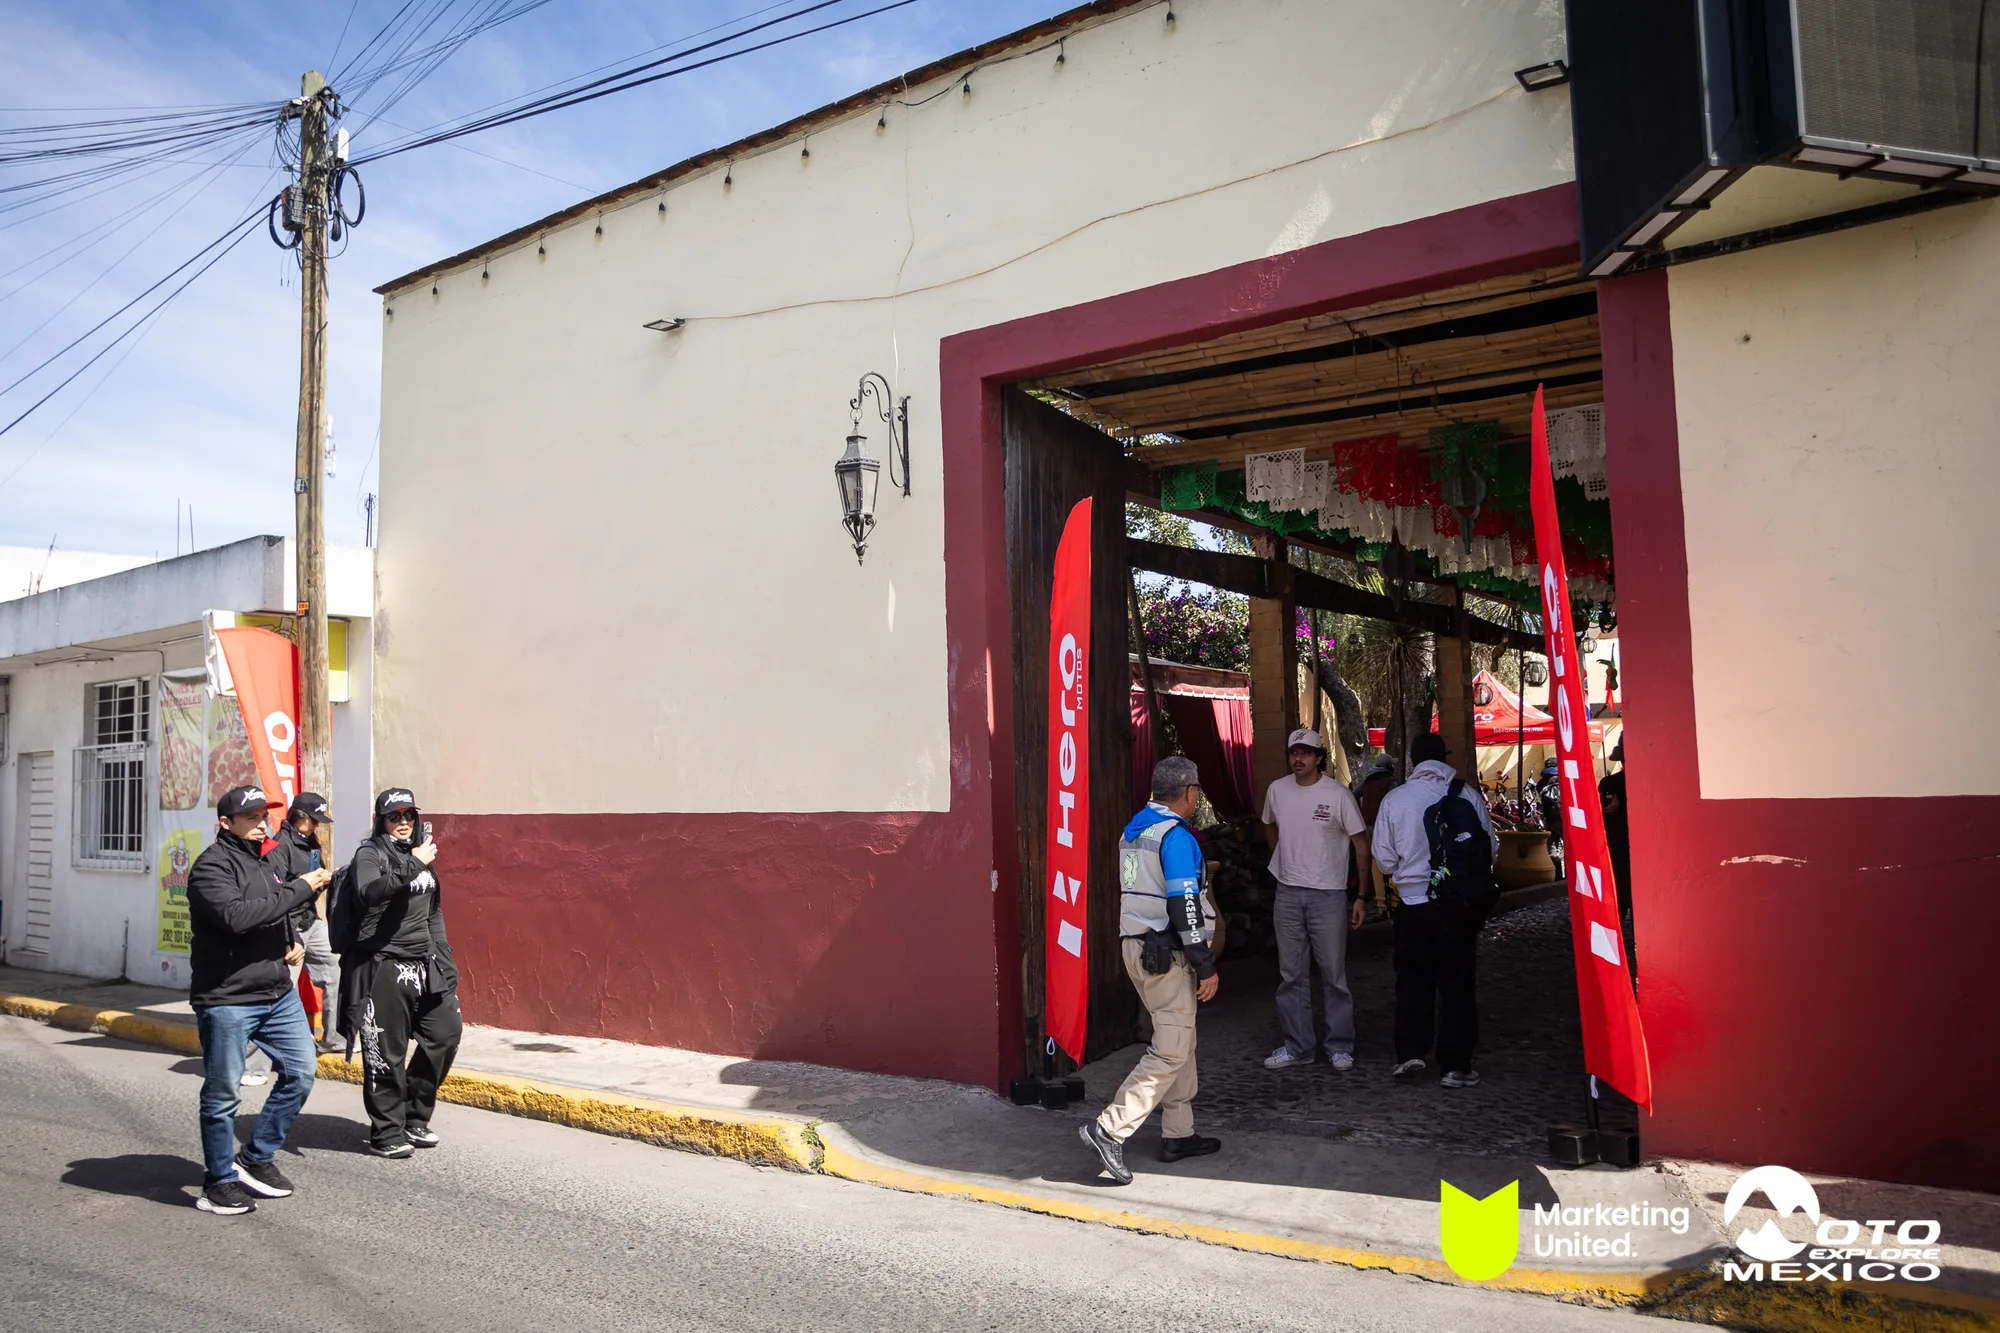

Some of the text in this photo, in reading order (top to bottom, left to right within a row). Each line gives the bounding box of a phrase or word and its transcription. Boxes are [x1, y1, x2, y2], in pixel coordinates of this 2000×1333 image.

[1057, 632, 1076, 848] Hero
[1076, 647, 1084, 710] MOTOS
[1544, 562, 1588, 829] Hero
[1183, 881, 1202, 944] PARAMEDICO
